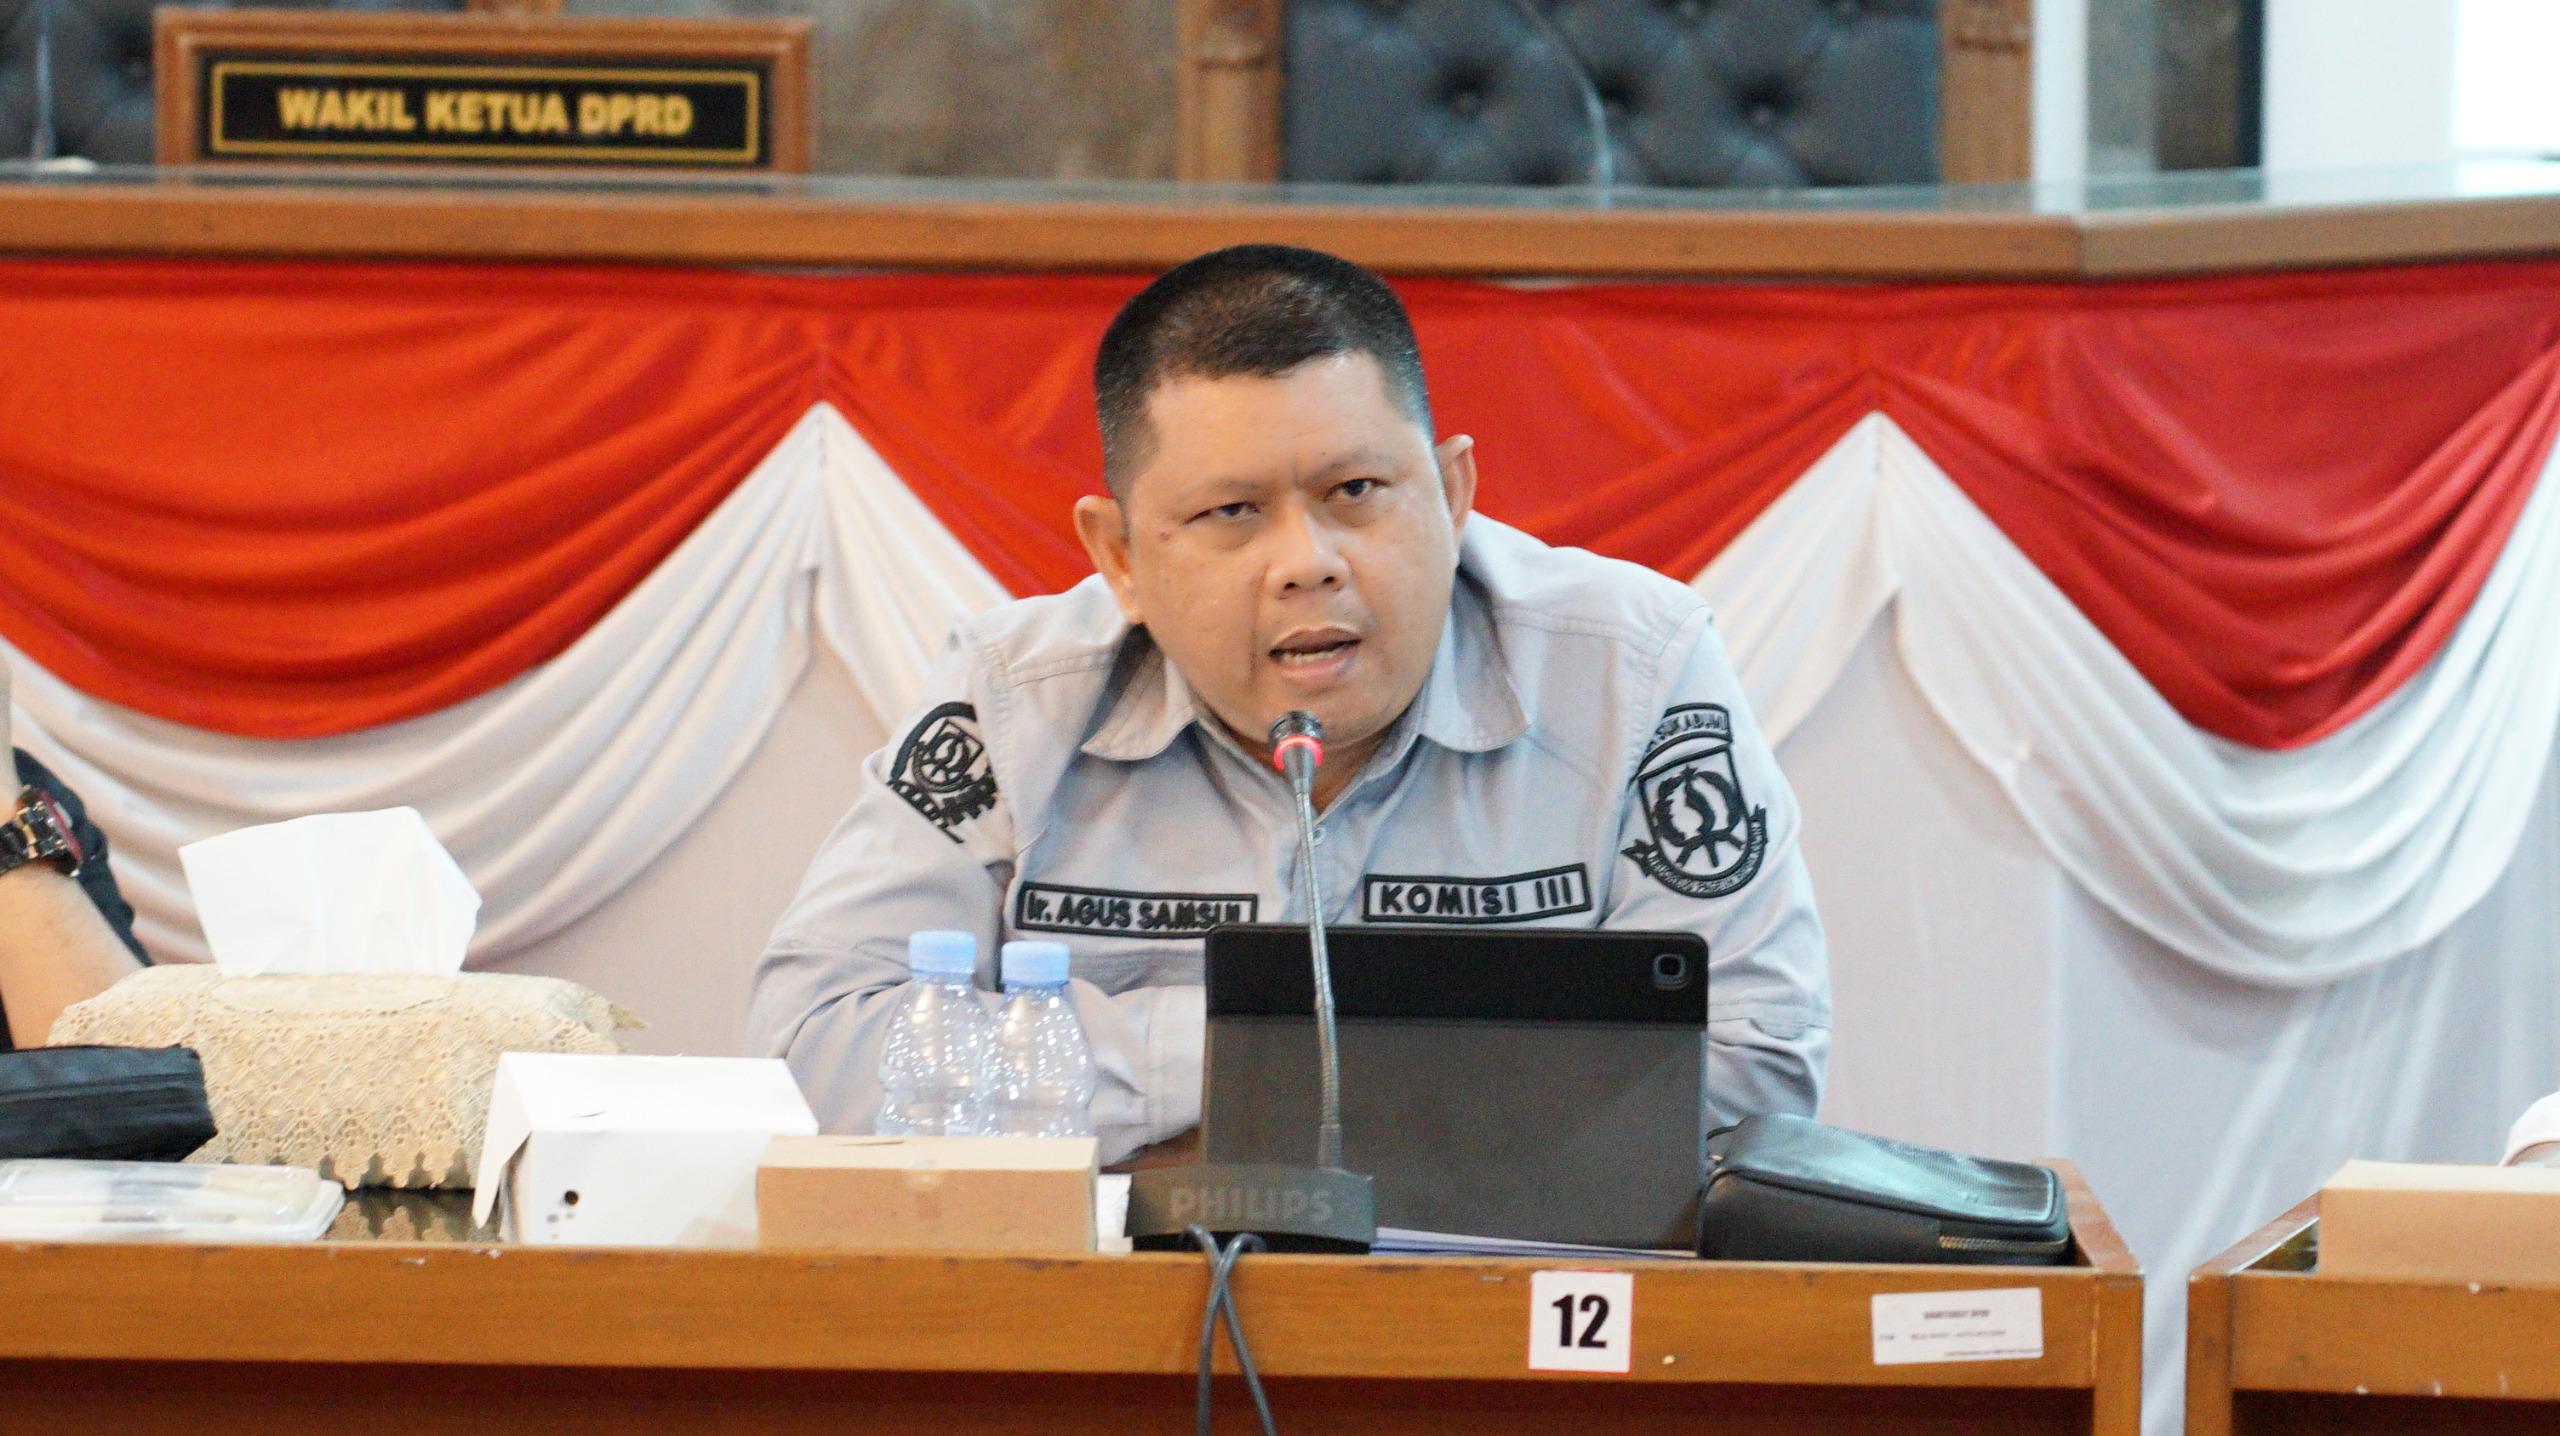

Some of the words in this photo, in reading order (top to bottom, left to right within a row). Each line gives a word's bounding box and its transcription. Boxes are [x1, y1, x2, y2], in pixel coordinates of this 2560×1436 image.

[278, 90, 415, 130] WAKIL
[425, 91, 570, 134] KETUA
[579, 94, 693, 136] DPRD
[1027, 891, 1050, 922] Ir.
[1056, 894, 1132, 928] AGUS
[1380, 884, 1517, 916] KOMISI
[1535, 875, 1572, 909] III
[1170, 1187, 1334, 1224] PHILIPS
[1552, 1293, 1609, 1348] 12
